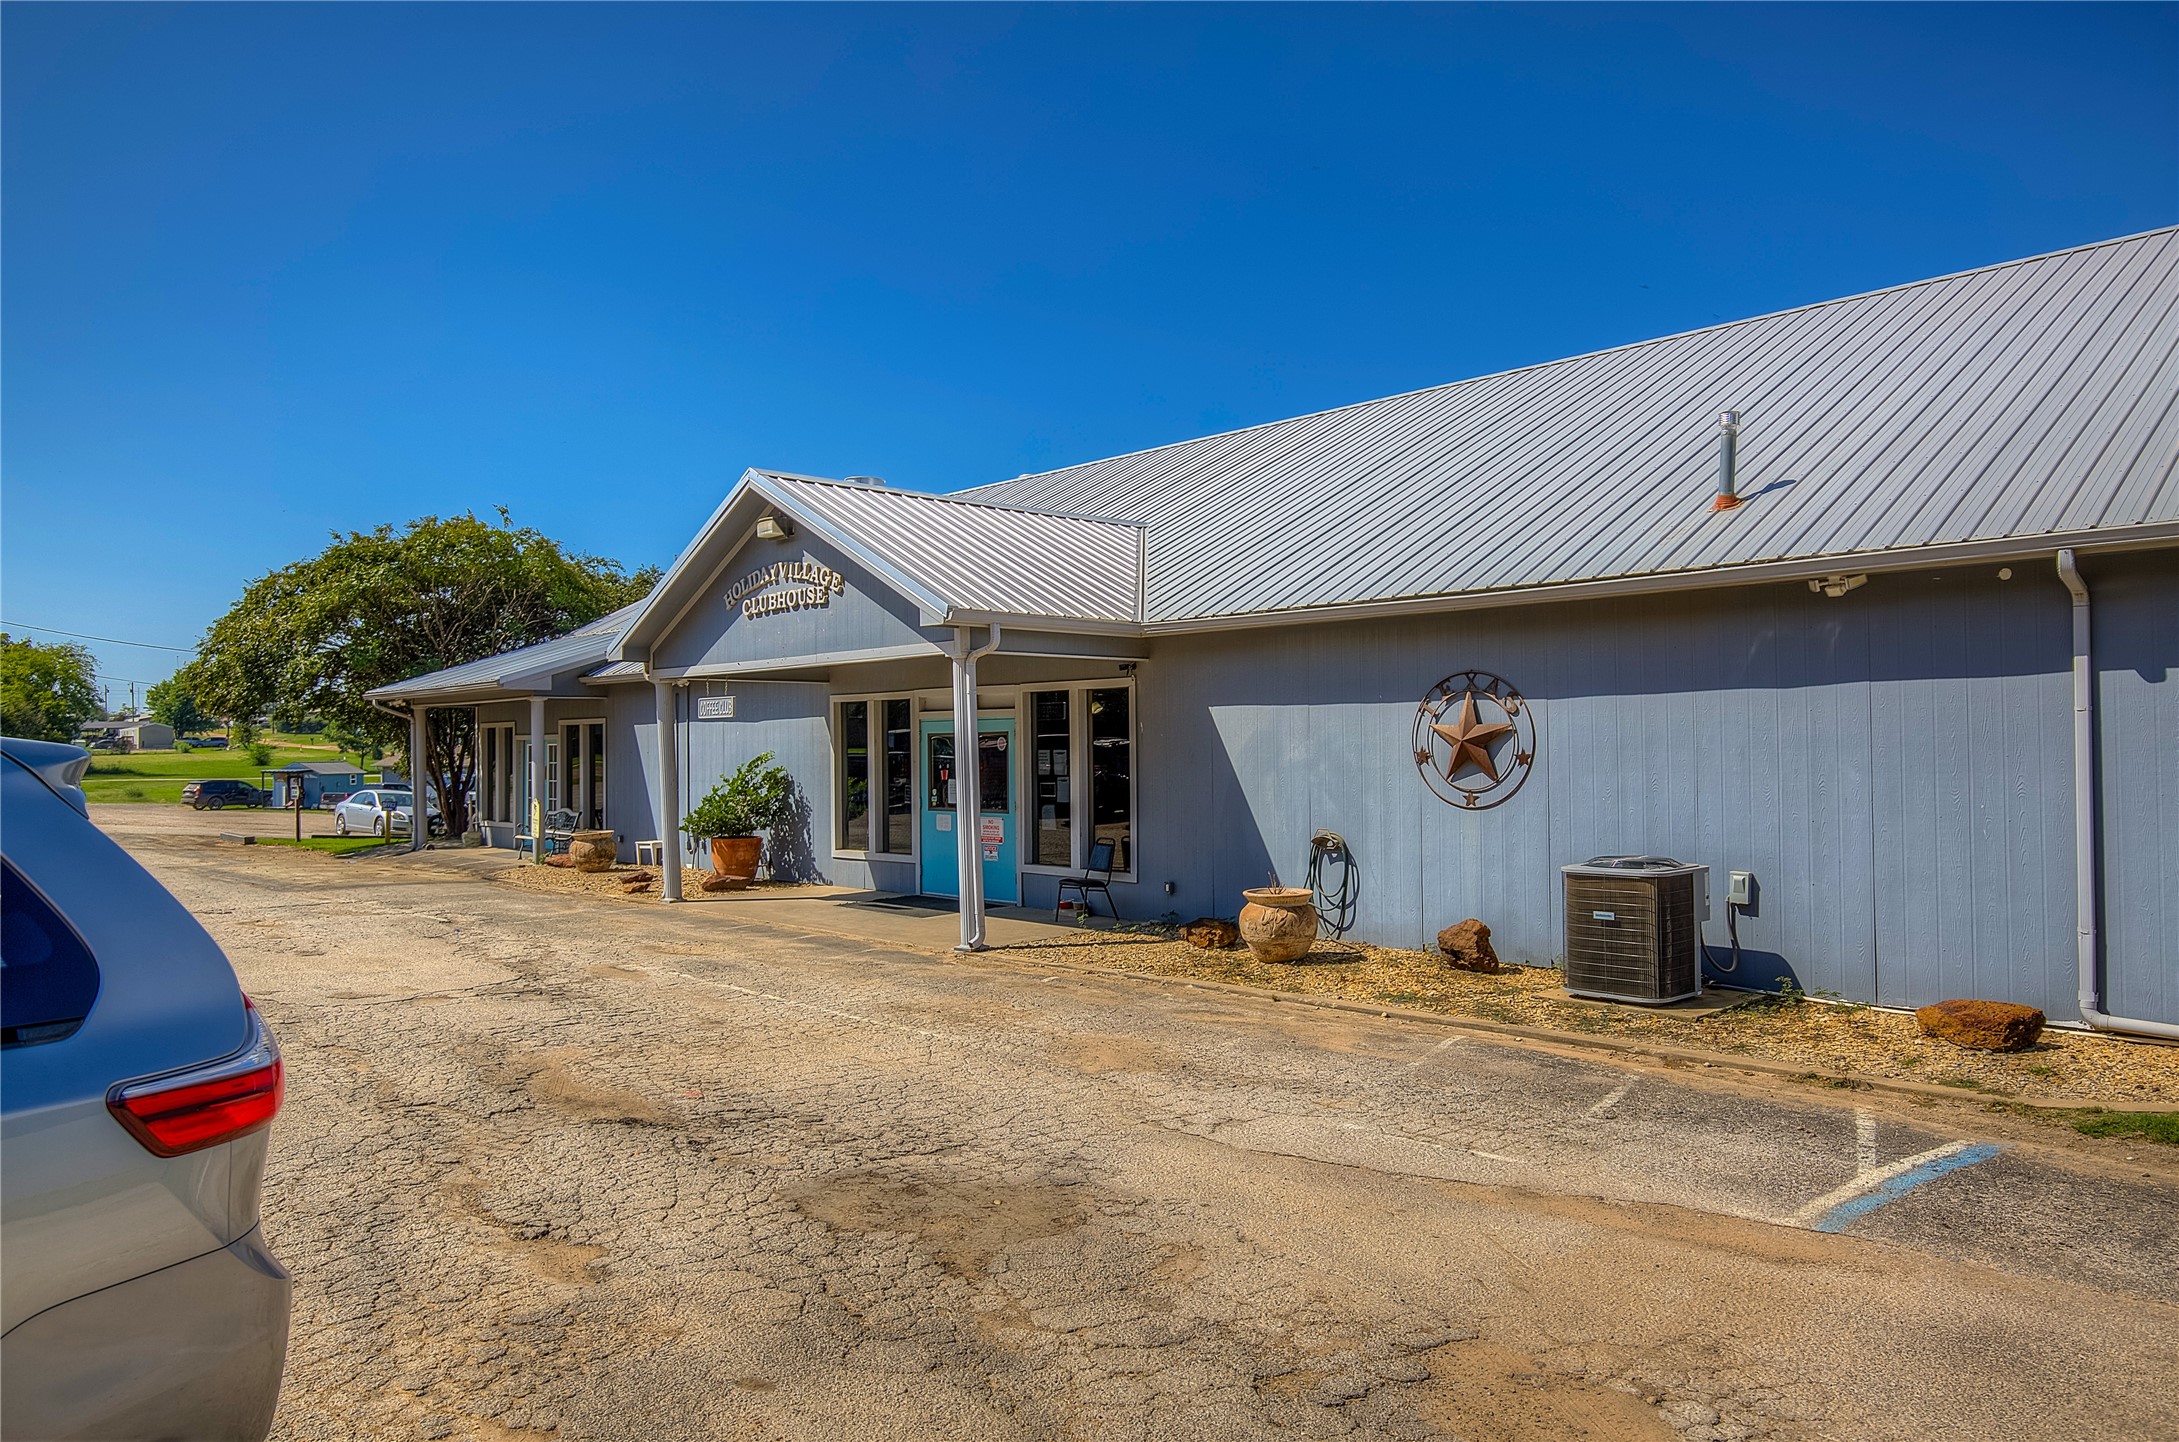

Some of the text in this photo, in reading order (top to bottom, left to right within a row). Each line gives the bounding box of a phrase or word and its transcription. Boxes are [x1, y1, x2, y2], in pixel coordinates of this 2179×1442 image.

[723, 562, 845, 611] HOLIDAY VILLAGE
[742, 587, 828, 616] CLUBHOUSE
[700, 700, 719, 716] COFFEE
[1418, 672, 1524, 719] TEXAS
